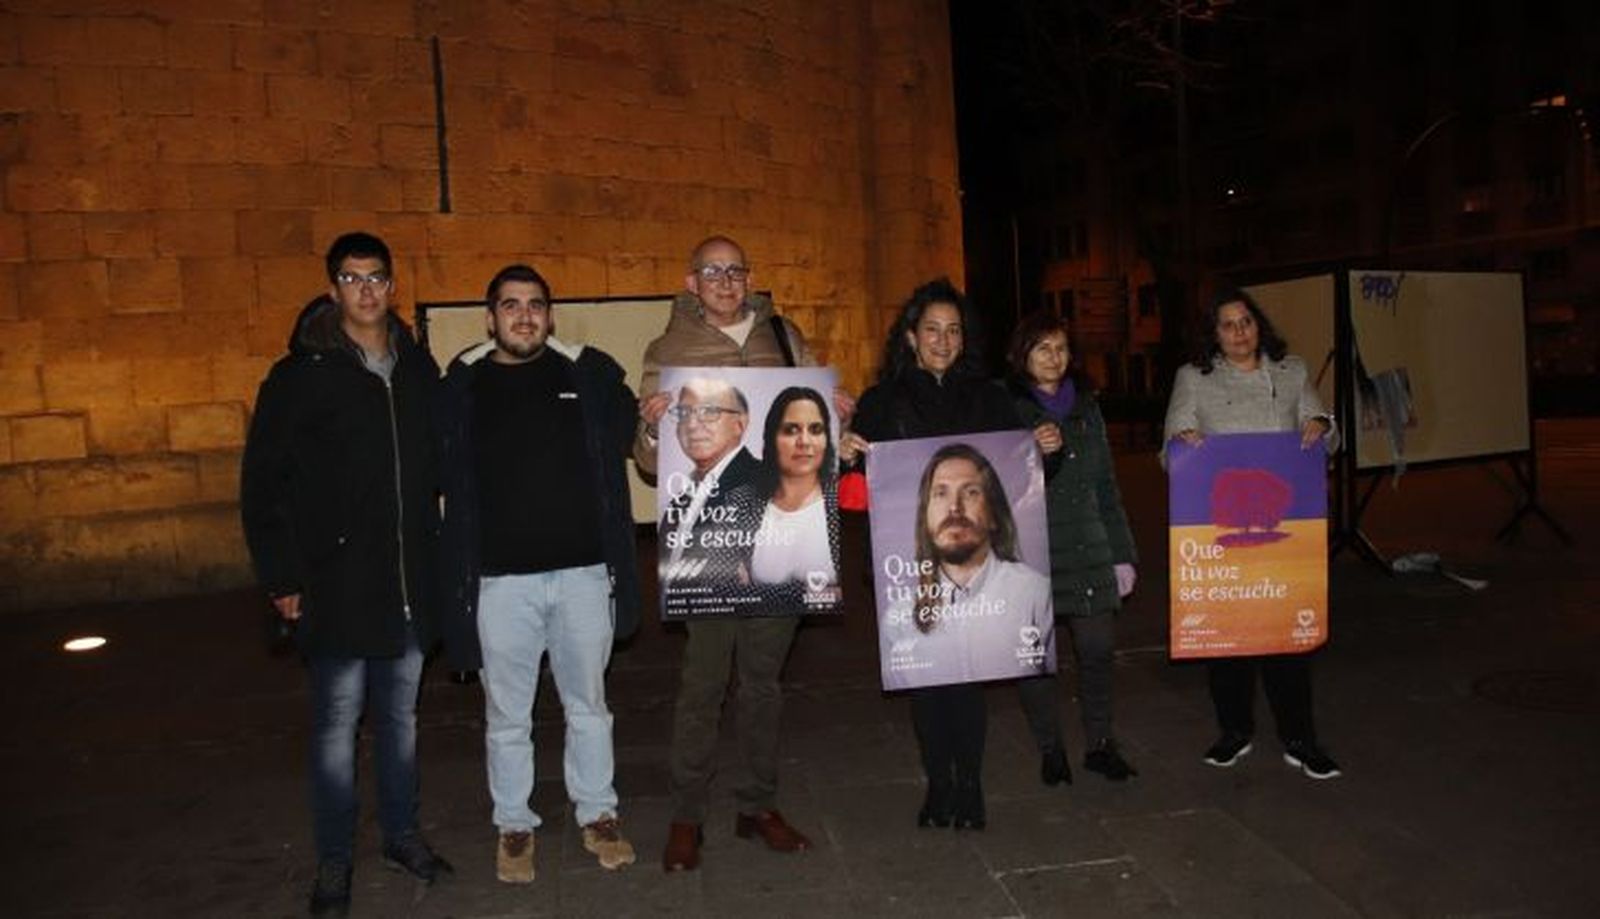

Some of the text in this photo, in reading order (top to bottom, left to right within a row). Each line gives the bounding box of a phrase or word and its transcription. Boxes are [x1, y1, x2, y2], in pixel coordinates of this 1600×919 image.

[667, 472, 719, 505] Que
[700, 506, 738, 523] voz
[666, 531, 694, 548] se
[1179, 537, 1225, 566] Que
[884, 554, 934, 585] Que
[1179, 565, 1241, 582] tu voz
[886, 582, 953, 602] tu voz
[1179, 576, 1288, 601] se escuche
[887, 593, 1007, 625] se escuche
